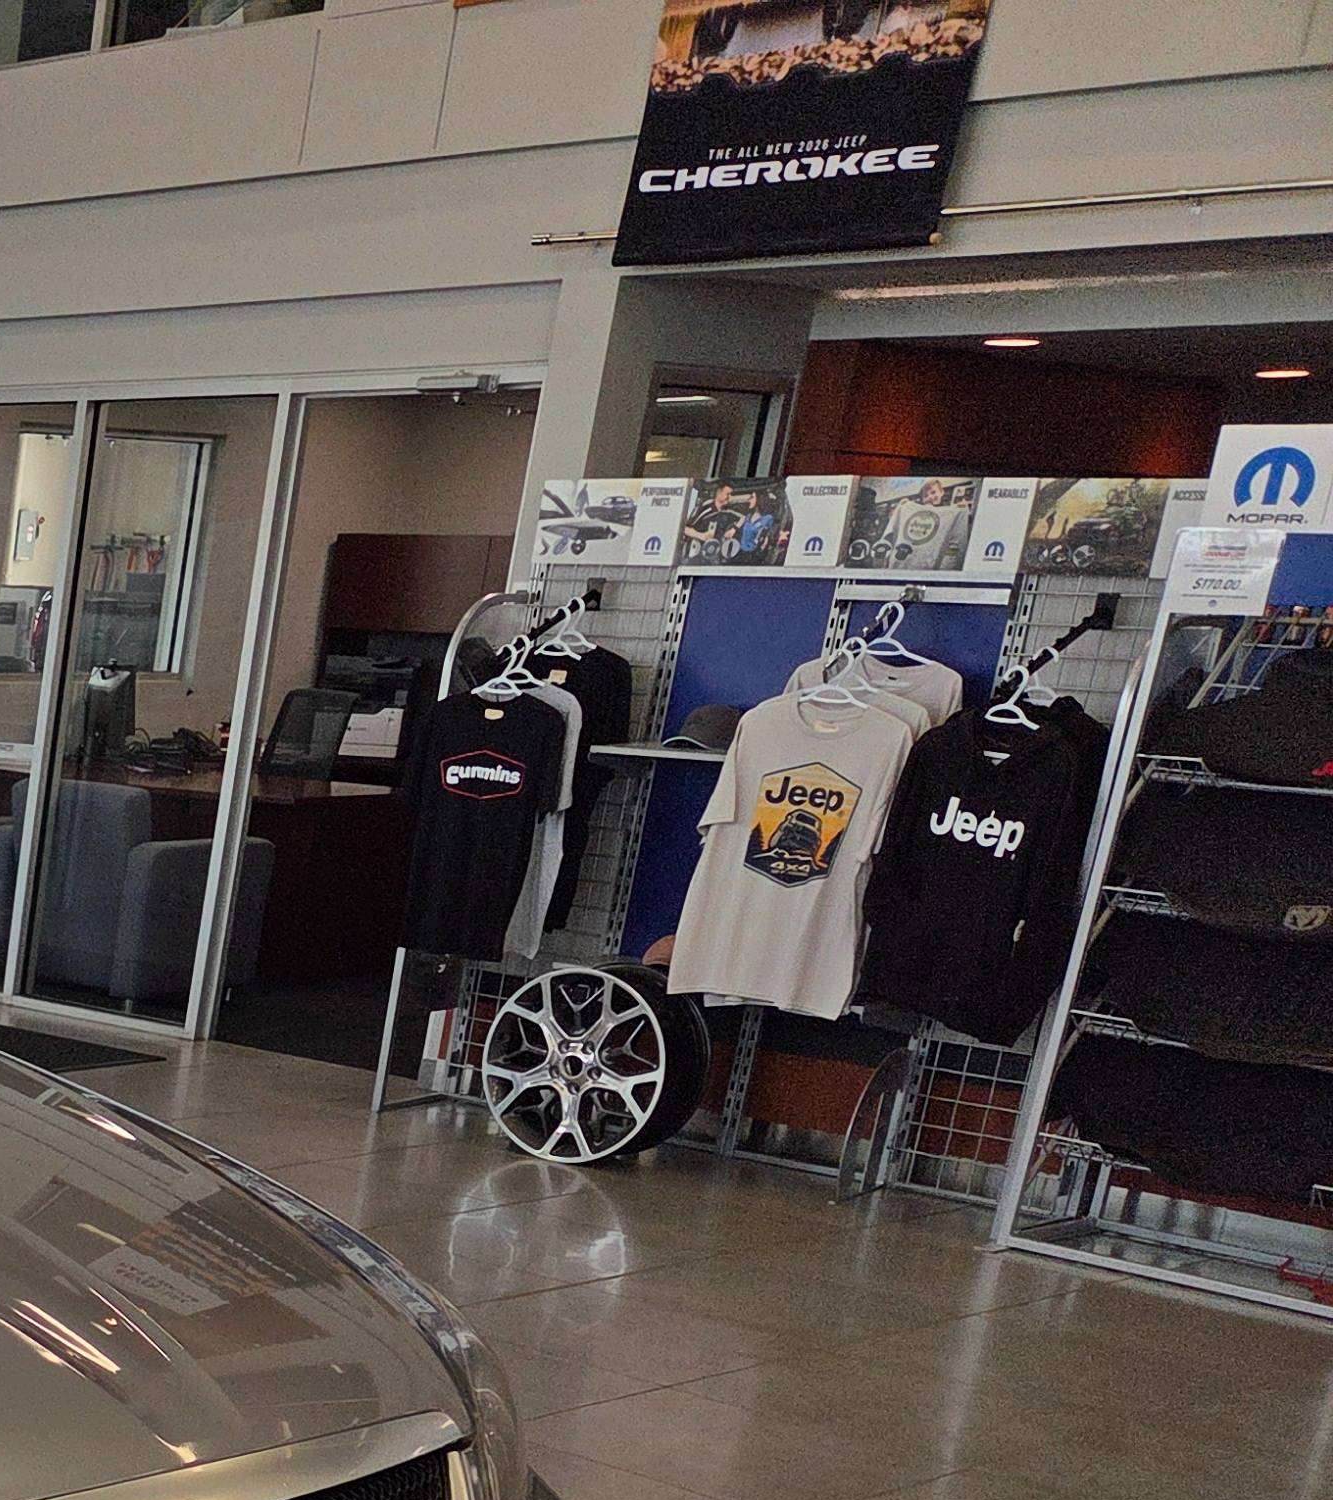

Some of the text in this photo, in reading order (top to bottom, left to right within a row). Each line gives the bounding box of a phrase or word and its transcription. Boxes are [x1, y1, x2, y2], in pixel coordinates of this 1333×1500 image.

[709, 149, 731, 160] THE
[737, 145, 759, 158] ALL
[765, 142, 792, 156] NEW
[834, 135, 867, 149] JEEP
[638, 144, 939, 192] CHEROKEE
[641, 486, 683, 497] PERFORMANCE
[802, 485, 848, 497] COLLECTIBLES
[987, 488, 1029, 500] WEARABLES
[1172, 489, 1206, 501] ACCESS
[1226, 513, 1305, 525] MOPAR
[446, 764, 521, 785] Cummins
[765, 776, 845, 816] Jeep
[930, 796, 1025, 858] Jeep
